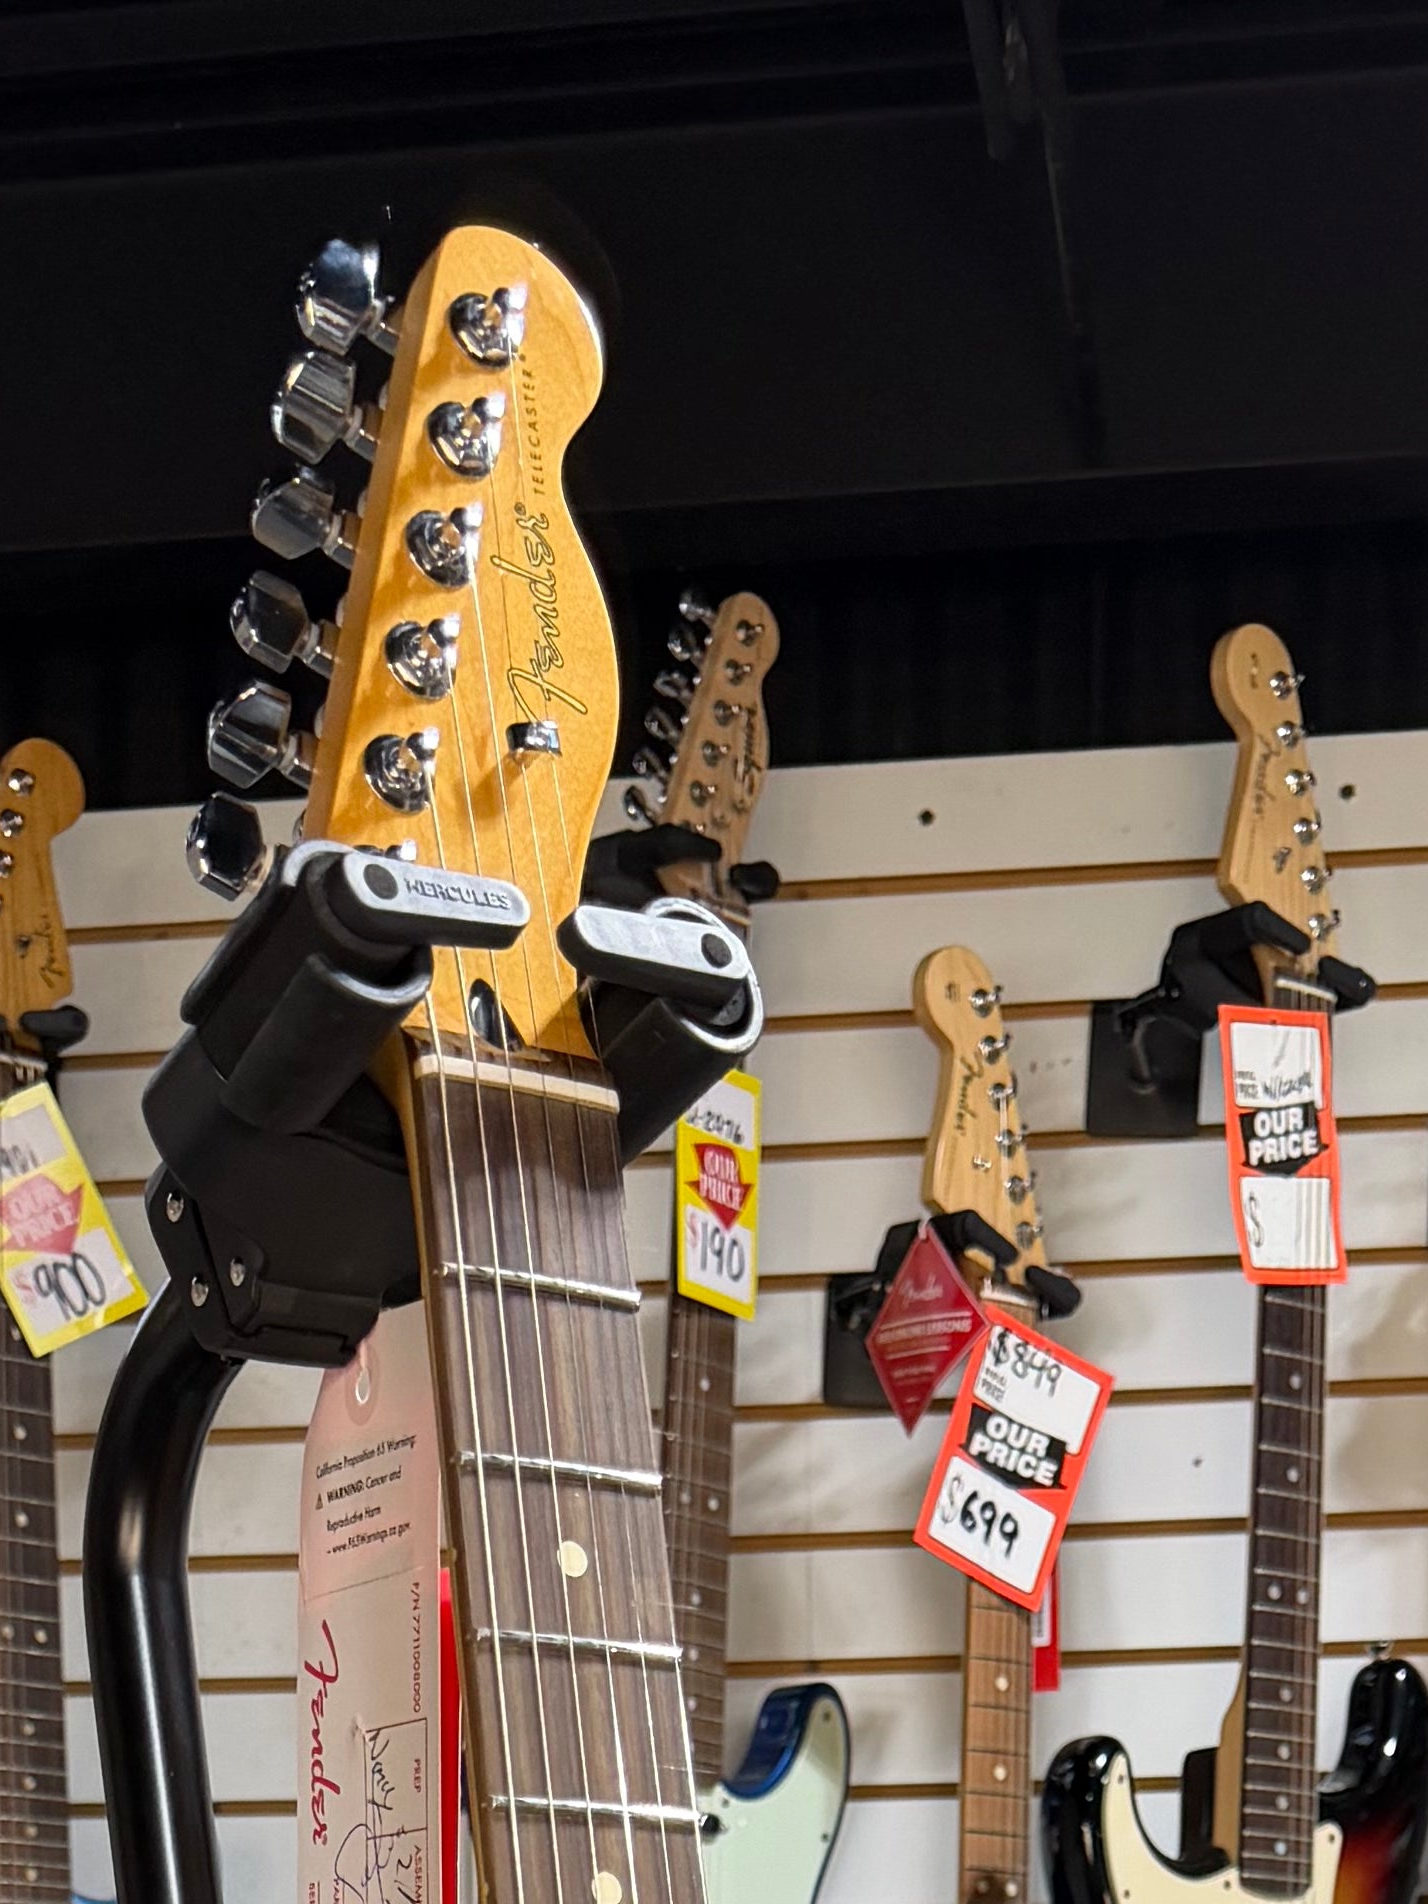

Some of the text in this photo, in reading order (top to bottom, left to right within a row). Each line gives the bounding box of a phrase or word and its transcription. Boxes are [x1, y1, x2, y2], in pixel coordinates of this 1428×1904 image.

[524, 367, 547, 497] TELECASTER
[490, 511, 588, 724] Fender
[403, 877, 511, 911] HERCULES
[1253, 1106, 1304, 1138] OUR
[702, 1147, 740, 1182] OUR
[1248, 1129, 1320, 1167] PRICE
[698, 1173, 744, 1212] PRICE
[985, 1413, 1051, 1457] OUR
[968, 1431, 1059, 1488] PRICE
[938, 1472, 1020, 1559] $699
[304, 1618, 341, 1846] Fender
[413, 1758, 422, 1793] PREP
